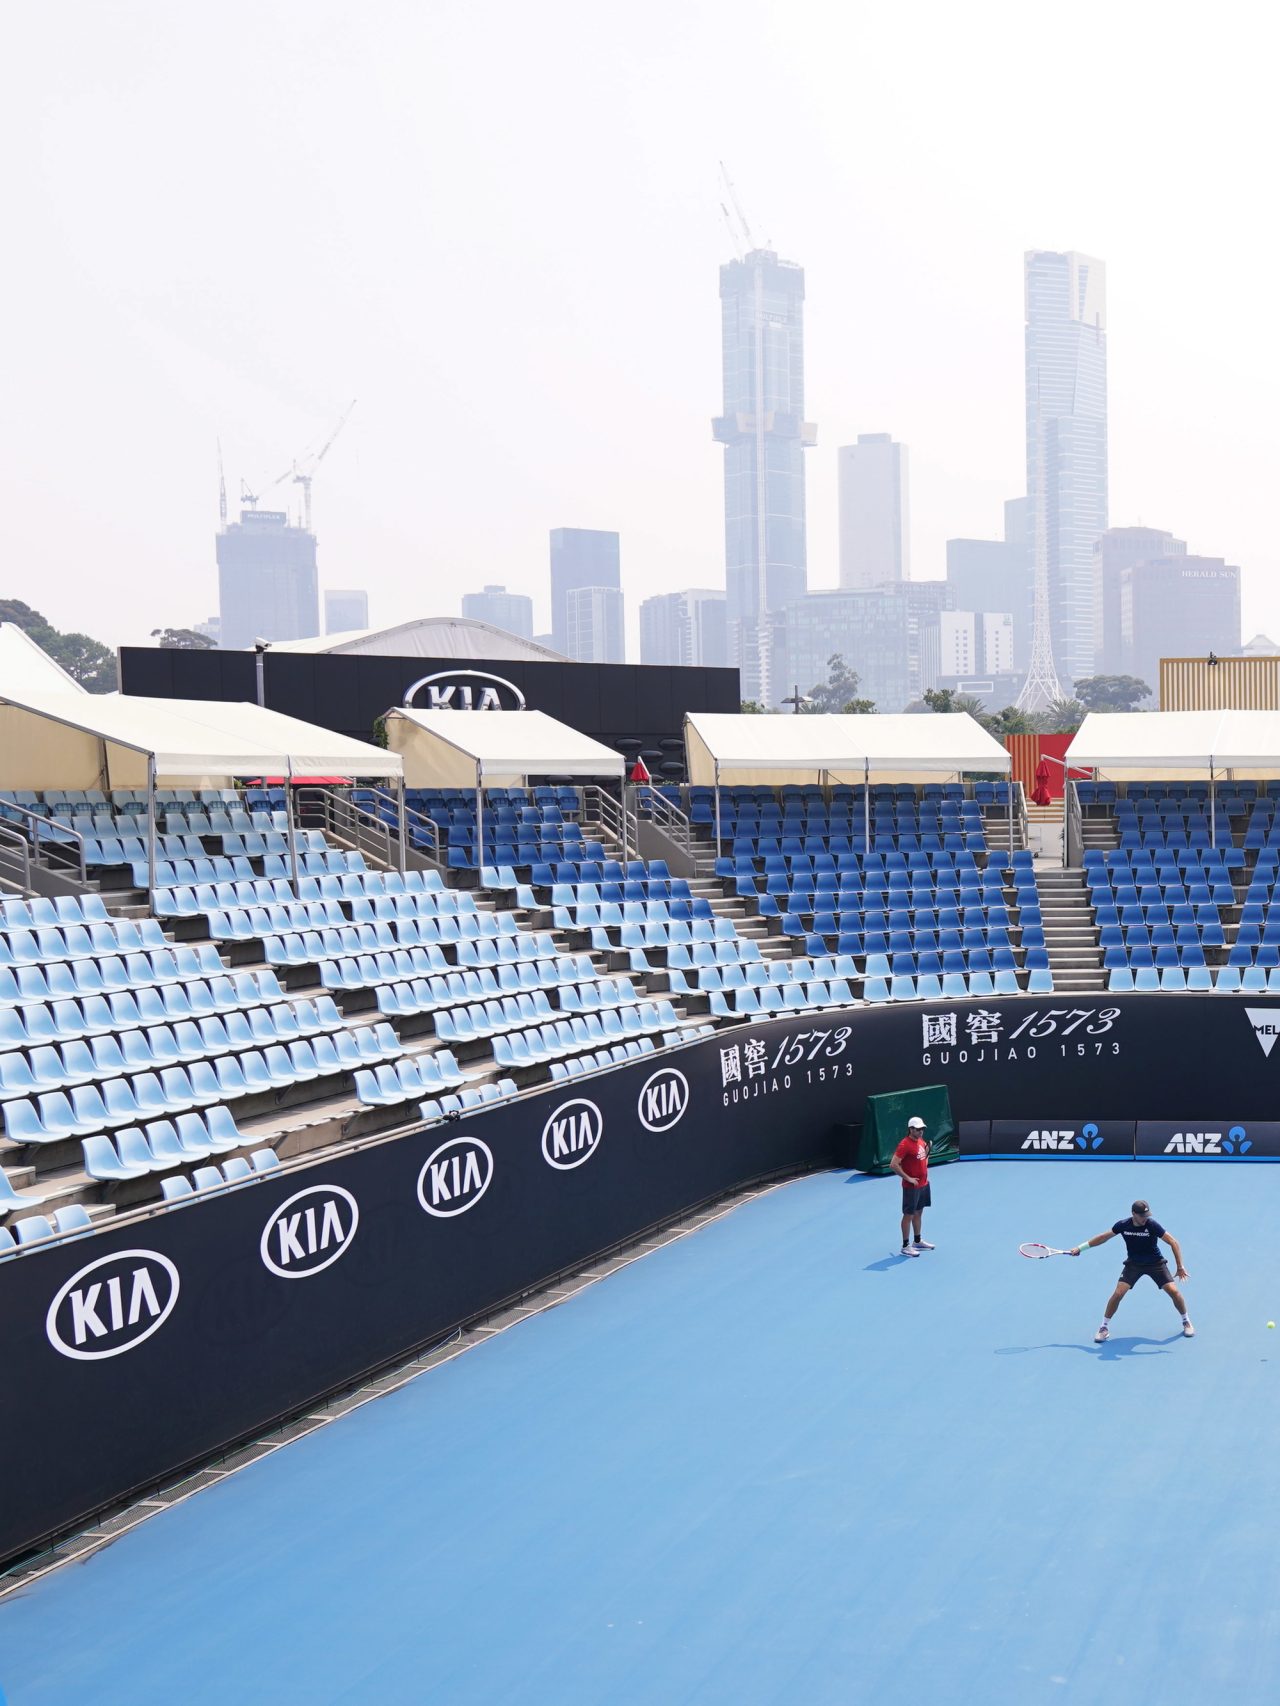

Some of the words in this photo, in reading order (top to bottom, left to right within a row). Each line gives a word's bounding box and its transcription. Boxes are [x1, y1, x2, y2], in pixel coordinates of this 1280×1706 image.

[1181, 570, 1217, 578] HERALD
[427, 685, 503, 710] KIA
[922, 1046, 1037, 1066] GUOJIAO
[1060, 1042, 1121, 1058] 1573
[645, 1078, 683, 1119] KIA
[722, 1074, 792, 1107] GUOJIAO
[806, 1062, 854, 1084] 1573
[552, 1107, 595, 1156] KIA
[1020, 1130, 1075, 1150] ANZ
[1163, 1132, 1222, 1154] ANZ
[429, 1150, 483, 1203] KIA
[277, 1199, 345, 1265] KIA
[68, 1267, 162, 1345] KIA
